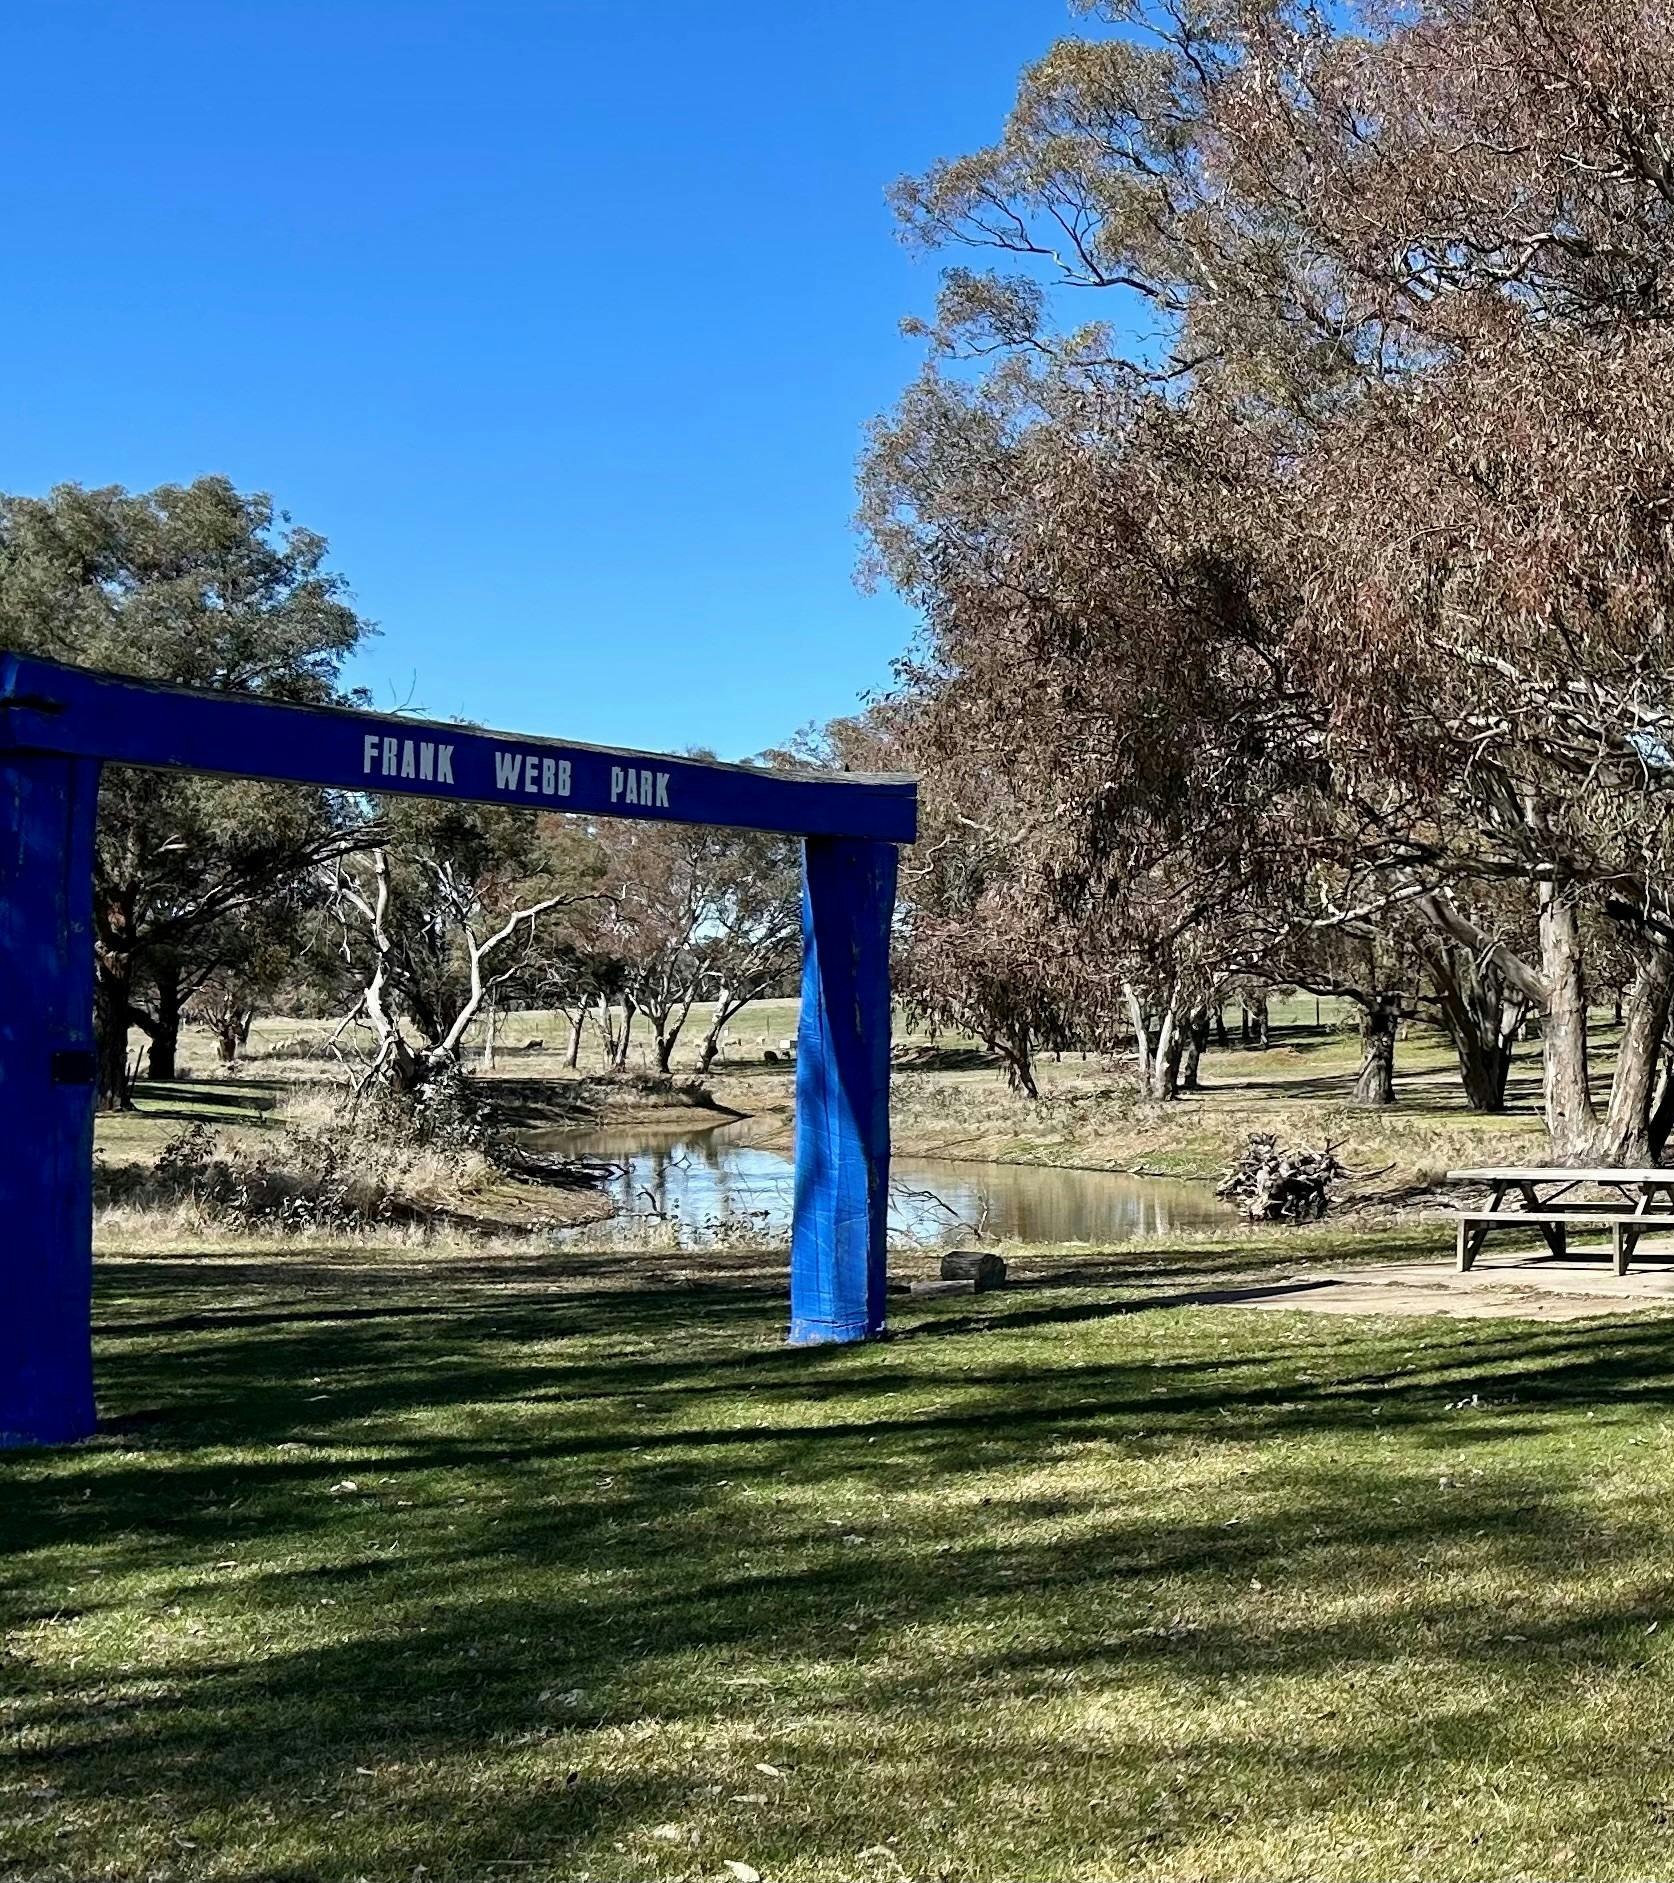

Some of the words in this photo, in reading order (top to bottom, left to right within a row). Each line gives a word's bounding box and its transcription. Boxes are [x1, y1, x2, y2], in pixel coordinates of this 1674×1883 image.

[363, 734, 455, 785] FRANK
[495, 751, 572, 797] WEBB
[610, 766, 670, 808] PARK
